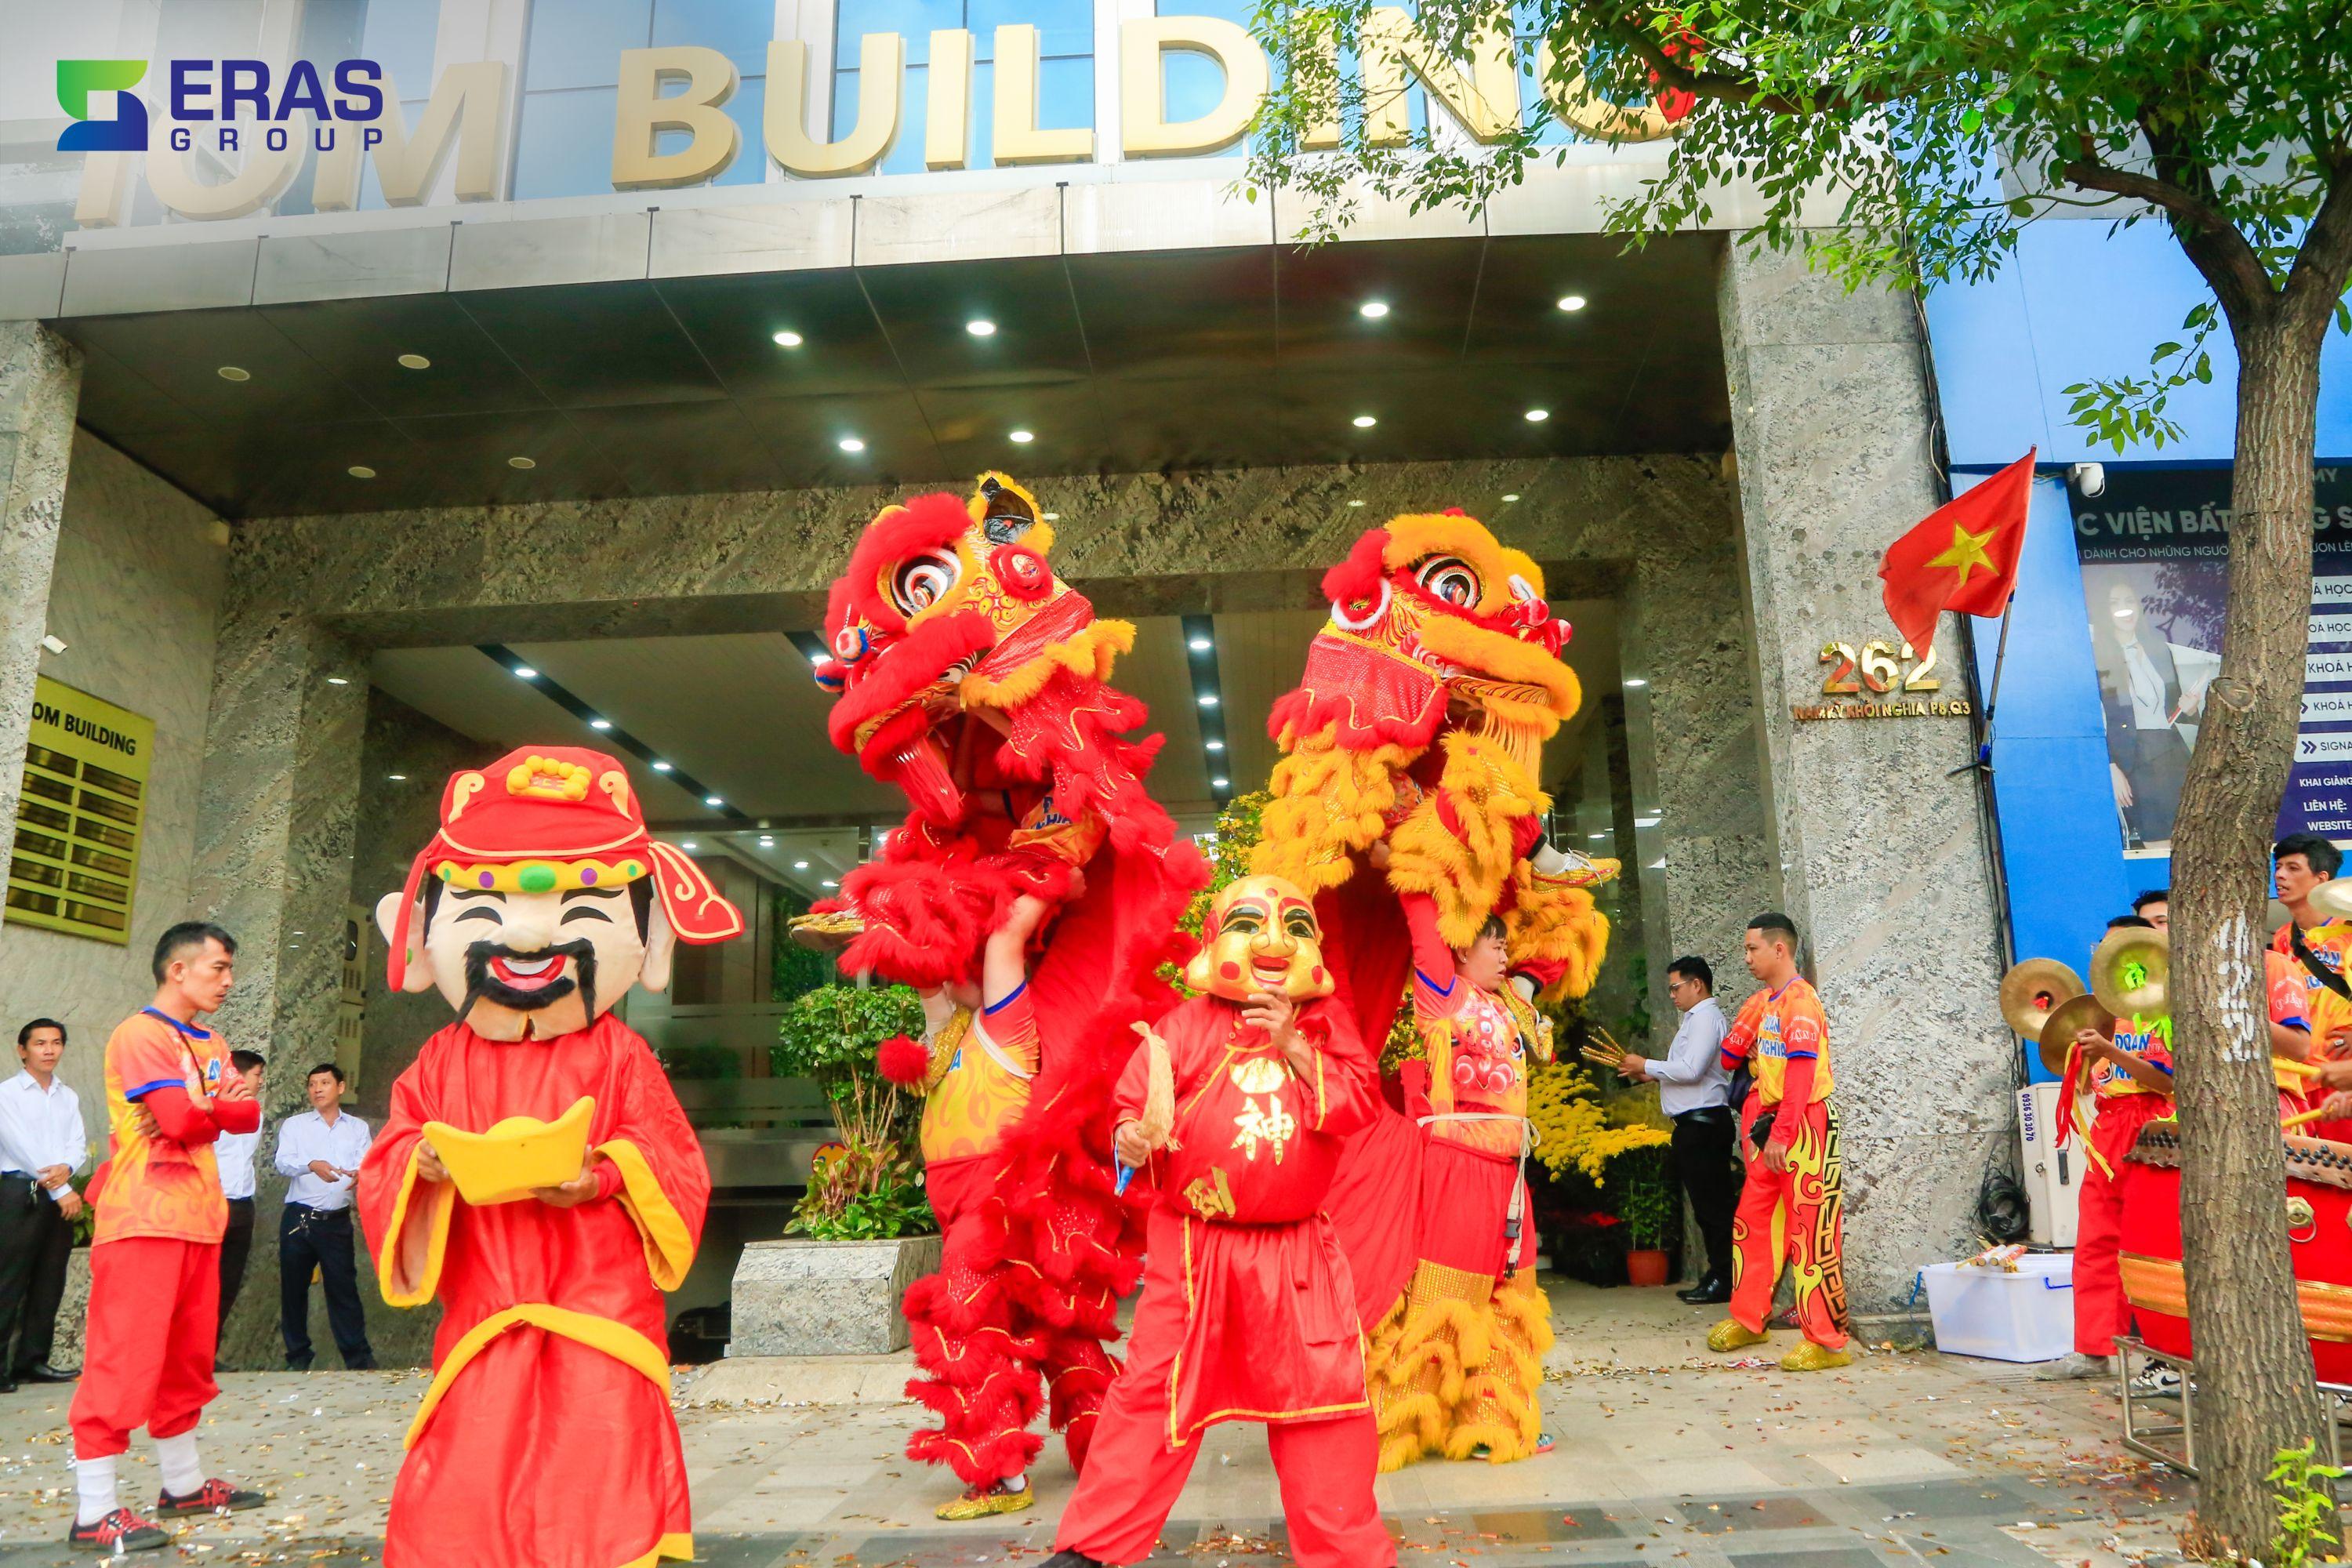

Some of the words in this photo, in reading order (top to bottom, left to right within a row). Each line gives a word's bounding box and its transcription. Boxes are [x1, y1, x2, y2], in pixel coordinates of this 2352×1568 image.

[2104, 506, 2173, 541] VIỆN
[2180, 501, 2230, 534] BẤT
[2084, 546, 2117, 559] DÀNH
[2119, 547, 2147, 558] CHO
[2149, 544, 2191, 557] NHỮNG
[2194, 544, 2230, 557] NGƯỜ
[2325, 583, 2352, 597] HỌC
[2327, 622, 2351, 635] HỌC
[1820, 640, 1940, 693] 262
[2307, 659, 2344, 673] KHOÁ
[2313, 699, 2346, 712] KHOÁ
[31, 701, 60, 728] OM
[64, 713, 137, 756] BUILDING
[2320, 741, 2352, 752] SIGNA
[2299, 778, 2322, 787] KHAI
[2303, 799, 2327, 812] LIÊN
[2328, 797, 2348, 813] HỆ:
